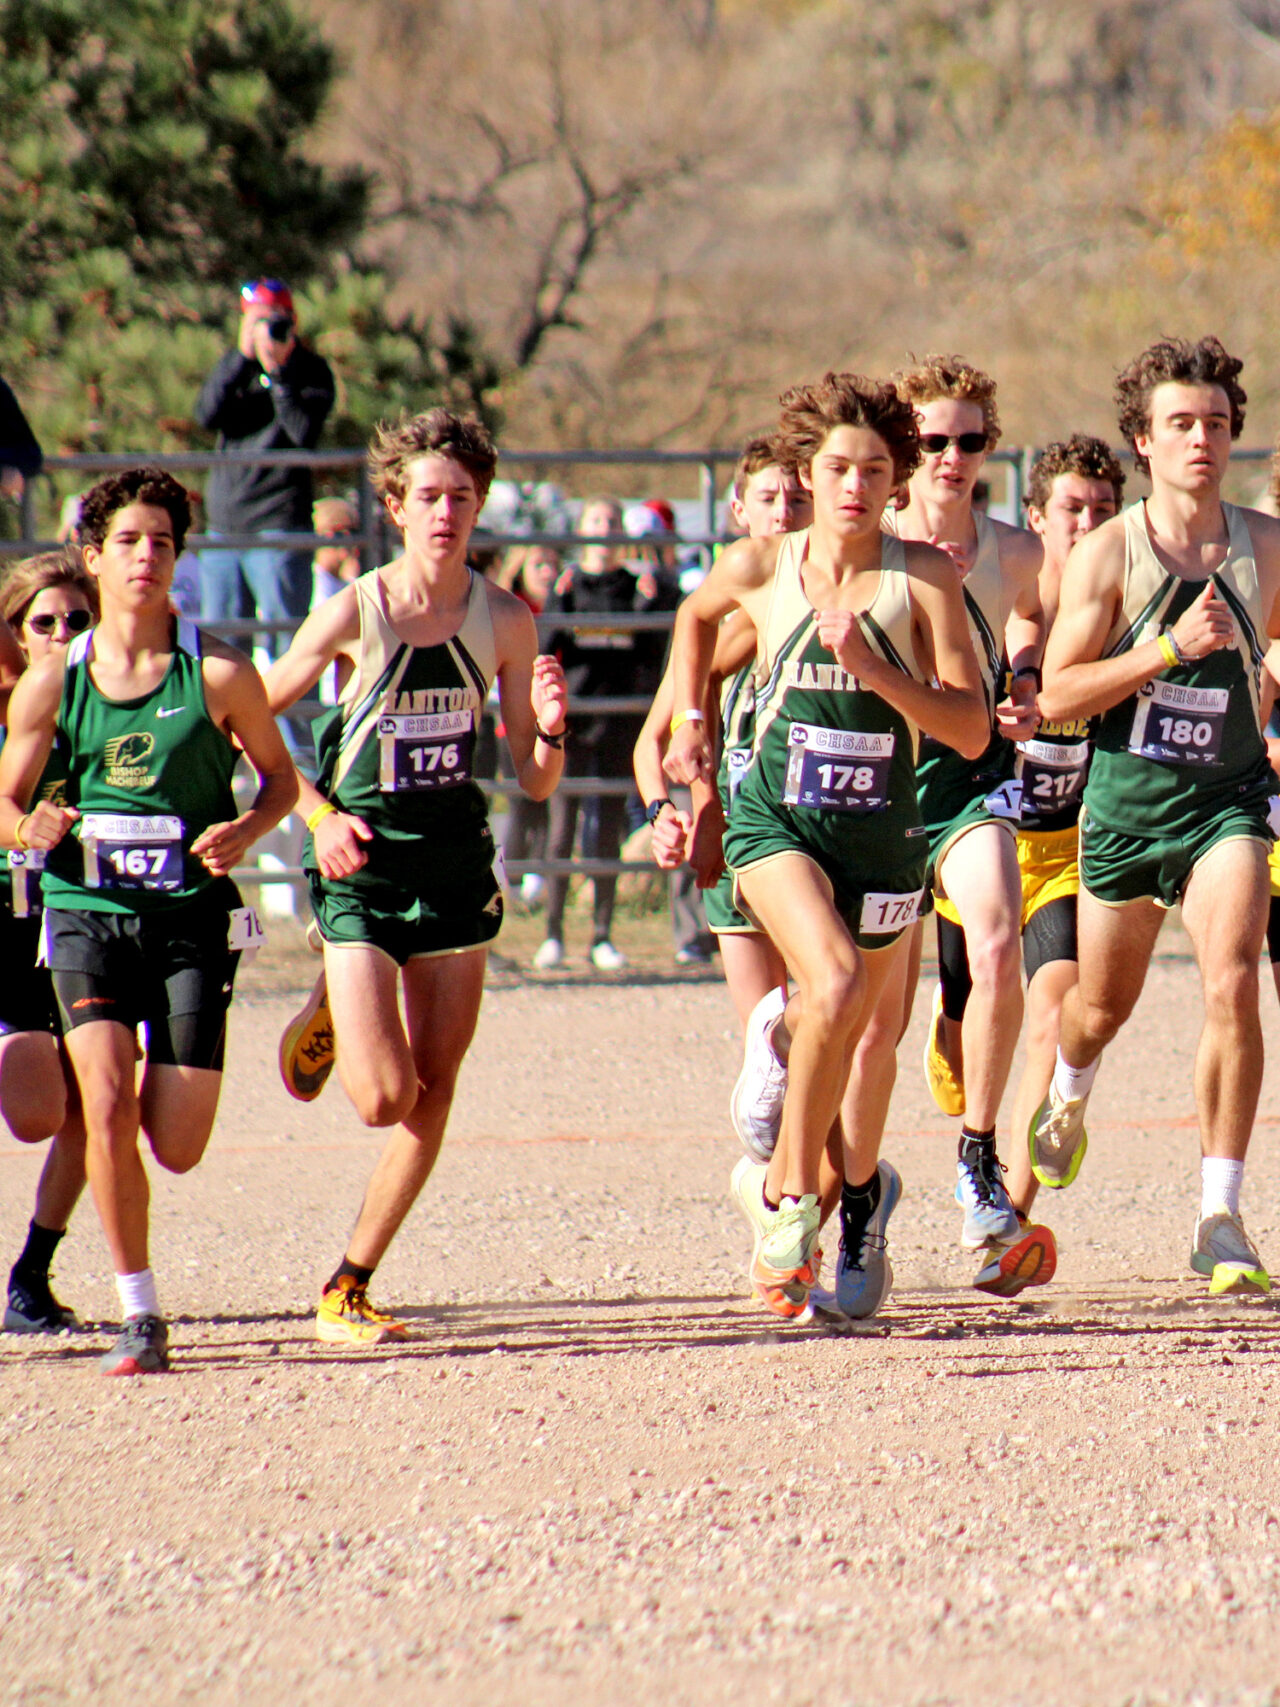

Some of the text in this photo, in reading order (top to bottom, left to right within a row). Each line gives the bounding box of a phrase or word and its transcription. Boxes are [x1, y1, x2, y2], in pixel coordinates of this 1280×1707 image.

[1161, 685, 1219, 707] CHSAA
[404, 713, 463, 733] CHSAA
[1159, 717, 1212, 746] 180
[816, 730, 883, 752] CHSAA
[408, 743, 459, 772] 176
[817, 763, 874, 792] 178
[1032, 770, 1081, 797] 217
[104, 818, 170, 835] CHSAA
[109, 849, 169, 875] 167
[877, 898, 914, 926] 178
